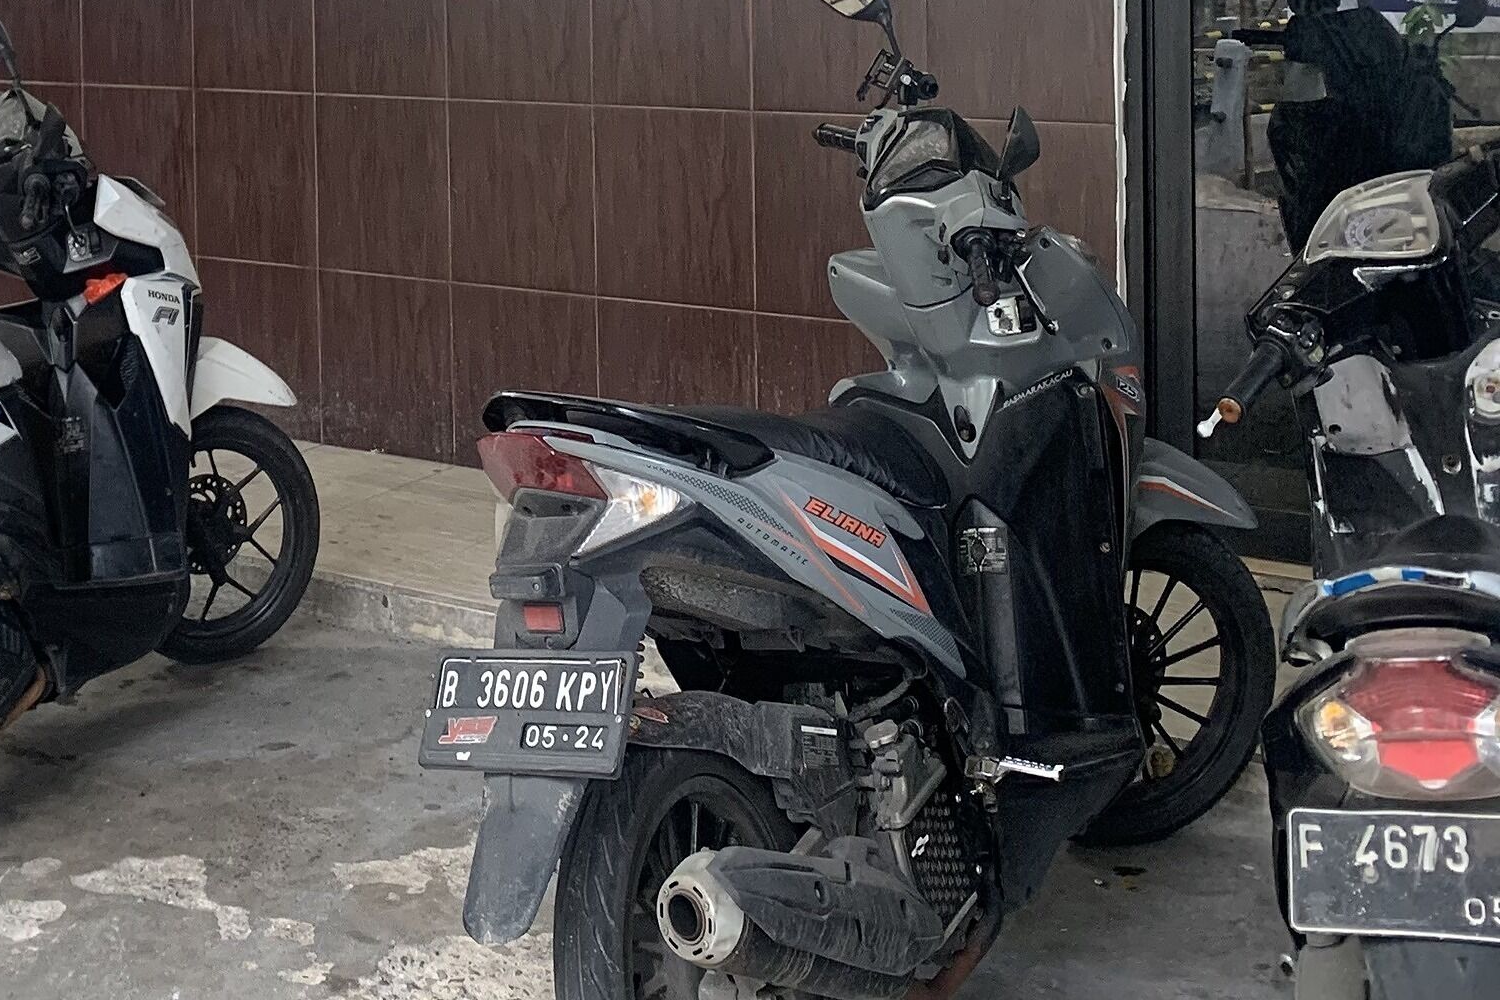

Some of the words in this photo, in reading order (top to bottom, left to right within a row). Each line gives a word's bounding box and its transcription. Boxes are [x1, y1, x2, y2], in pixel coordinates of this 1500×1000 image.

[148, 290, 180, 304] HONDA
[803, 496, 887, 548] ELIANA
[442, 670, 459, 708] B
[476, 668, 548, 708] 3606
[555, 670, 615, 711] KPY
[1299, 823, 1324, 869] F
[1354, 824, 1470, 873] 4673
